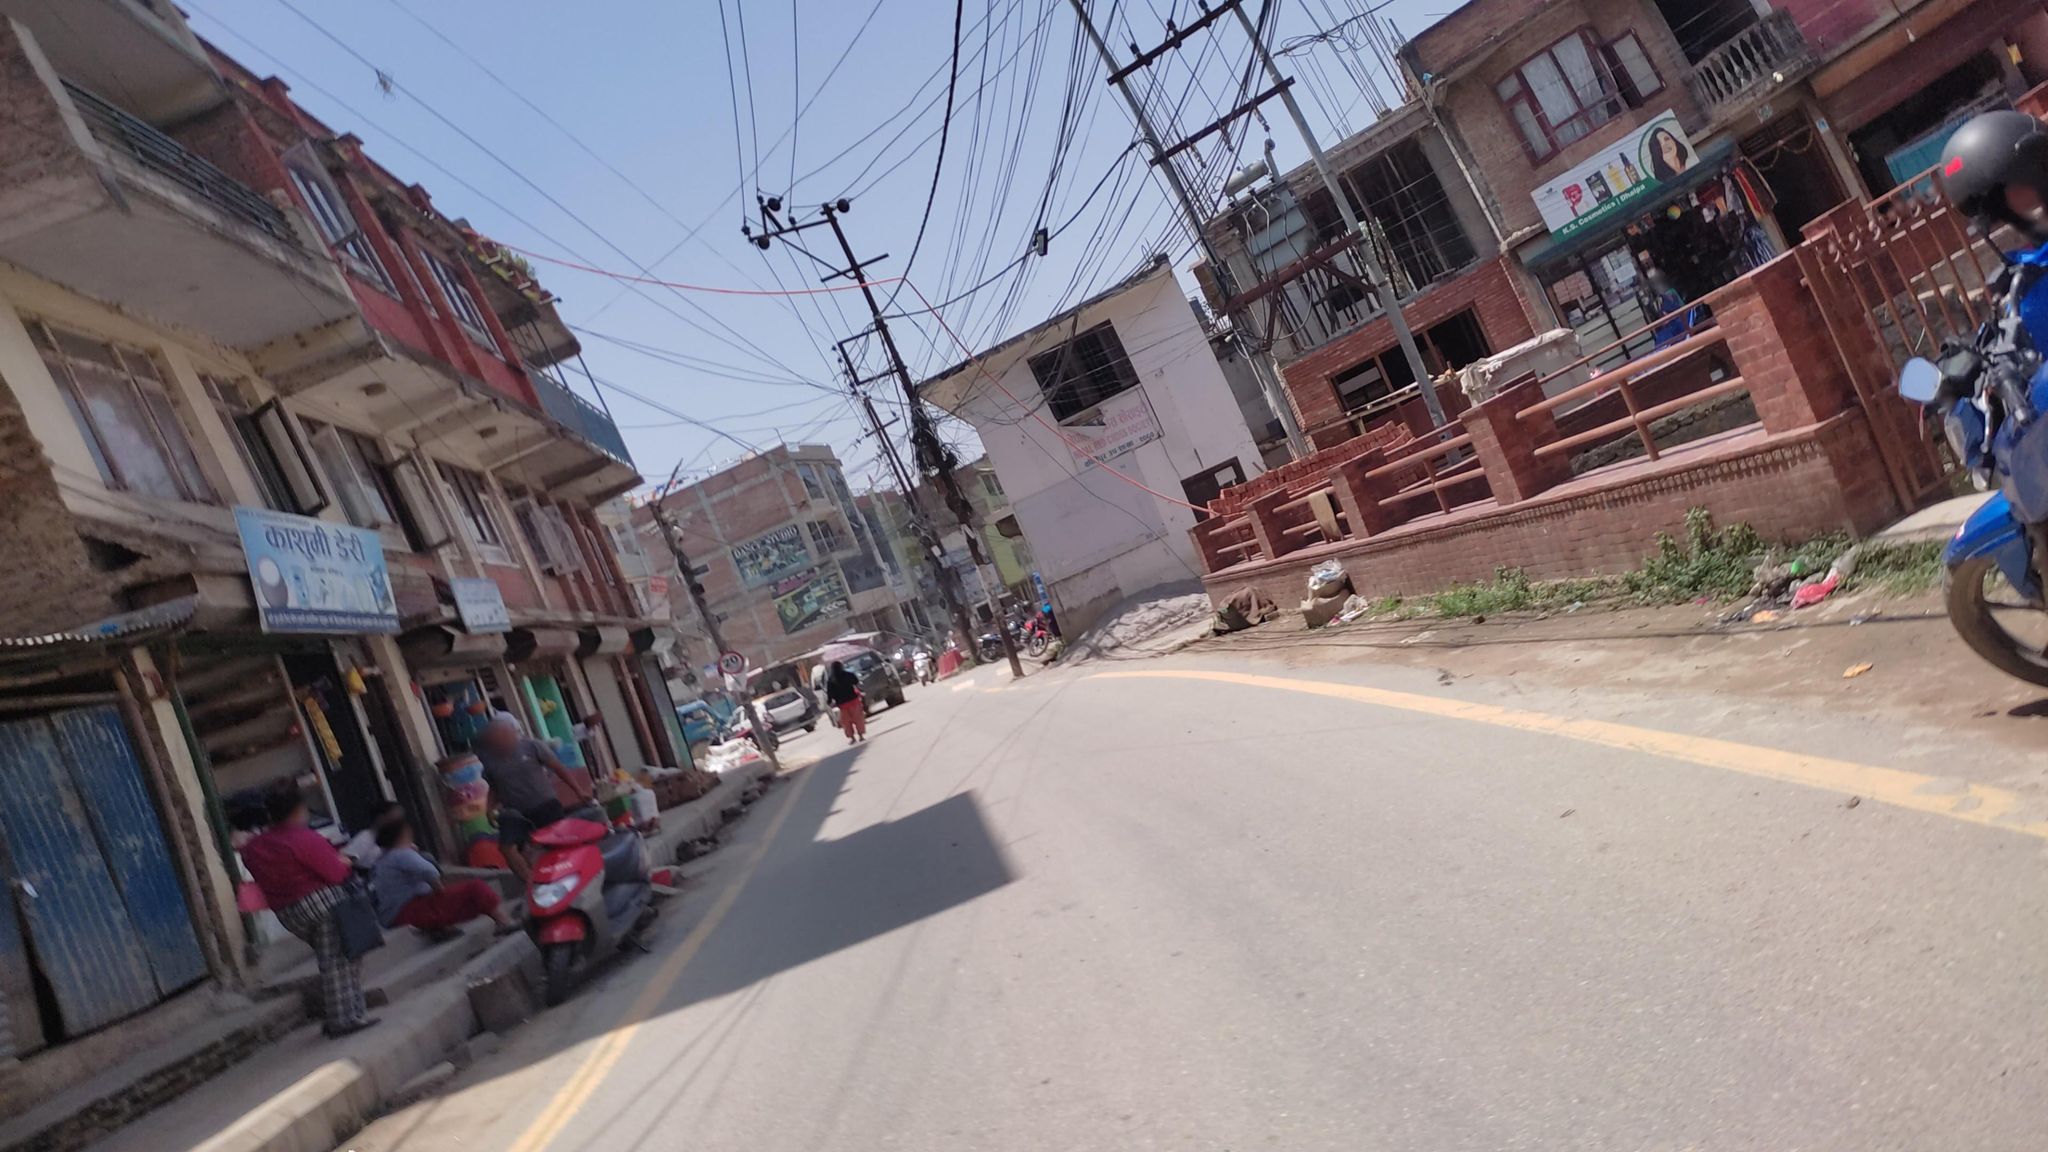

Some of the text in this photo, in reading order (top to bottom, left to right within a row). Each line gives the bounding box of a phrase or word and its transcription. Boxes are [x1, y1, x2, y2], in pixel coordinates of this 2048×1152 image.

[1578, 201, 1616, 226] Cosmetics
[333, 529, 366, 563] डेरी
[722, 654, 738, 669] 20
